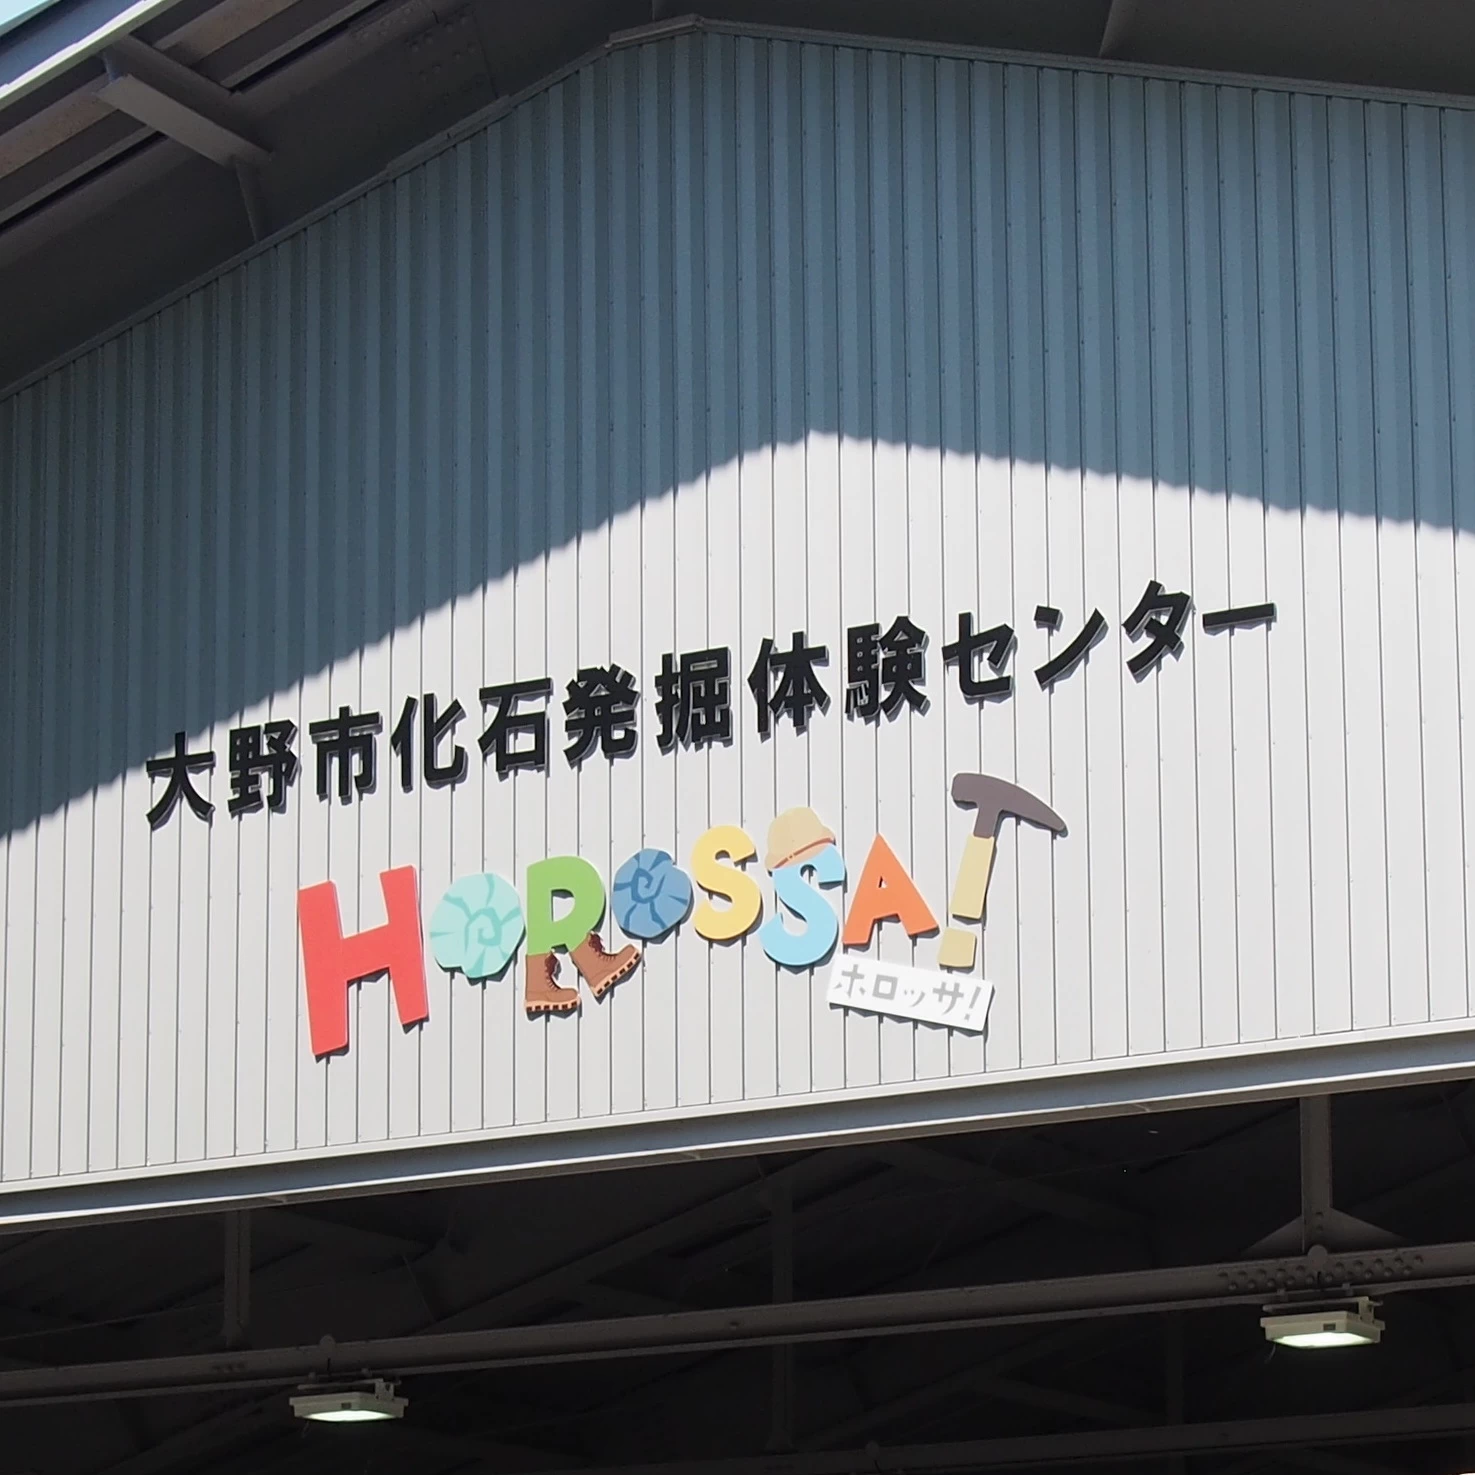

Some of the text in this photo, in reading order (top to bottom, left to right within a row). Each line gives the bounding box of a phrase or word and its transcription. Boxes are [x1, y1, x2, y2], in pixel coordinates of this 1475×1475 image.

[146, 580, 1276, 829] 大野市化石発掘体験センター
